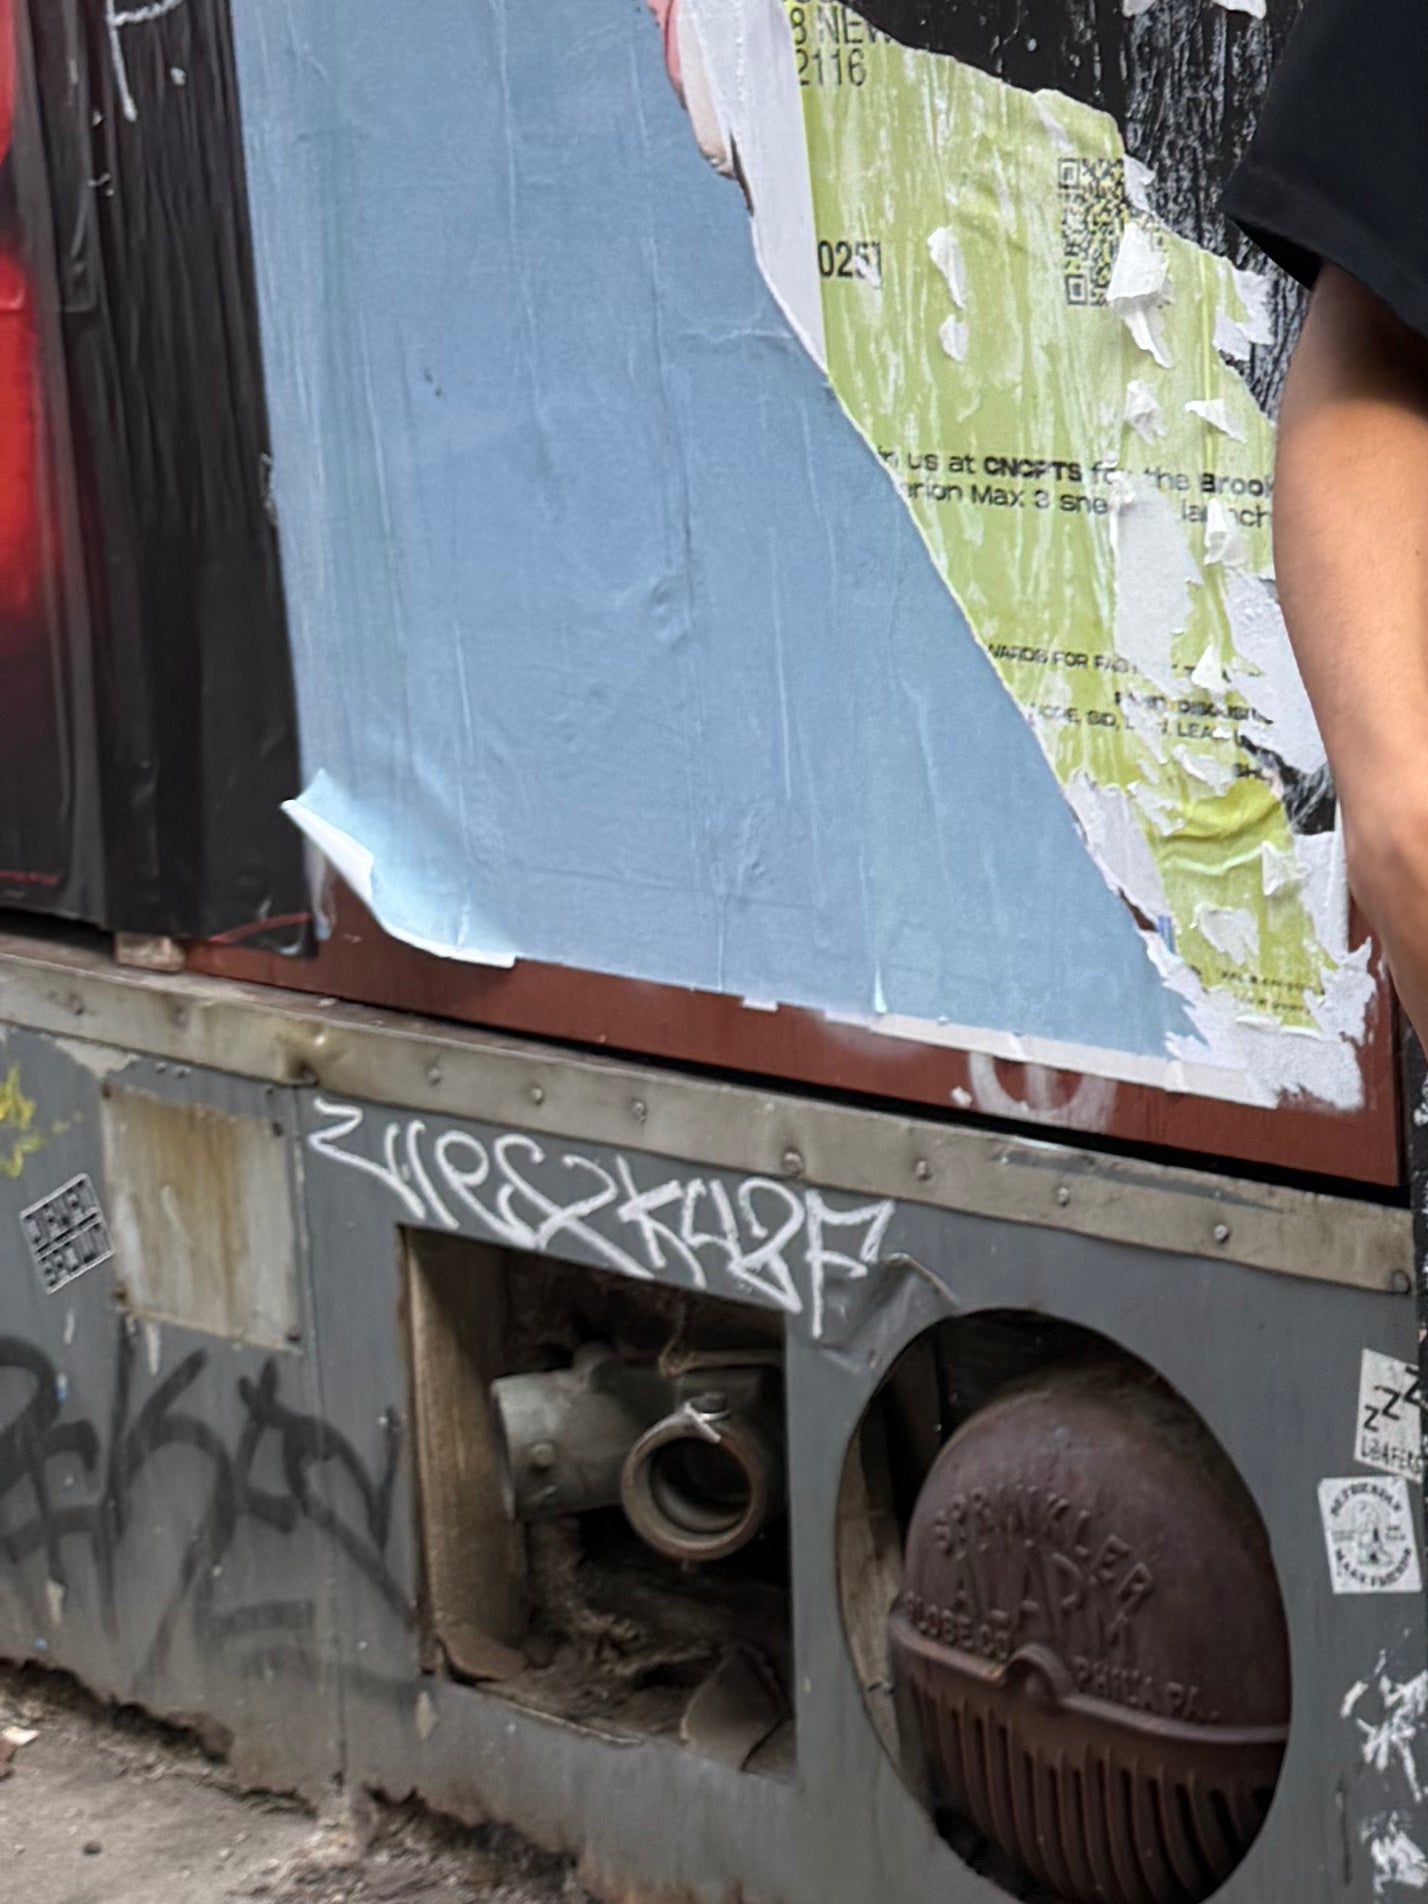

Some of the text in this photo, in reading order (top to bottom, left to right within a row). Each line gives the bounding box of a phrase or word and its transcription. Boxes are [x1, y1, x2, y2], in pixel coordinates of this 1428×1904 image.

[796, 47, 867, 87] 2116
[907, 452, 939, 471] us
[949, 453, 977, 475] at
[970, 482, 1025, 508] Max
[1053, 651, 1088, 667] FOR
